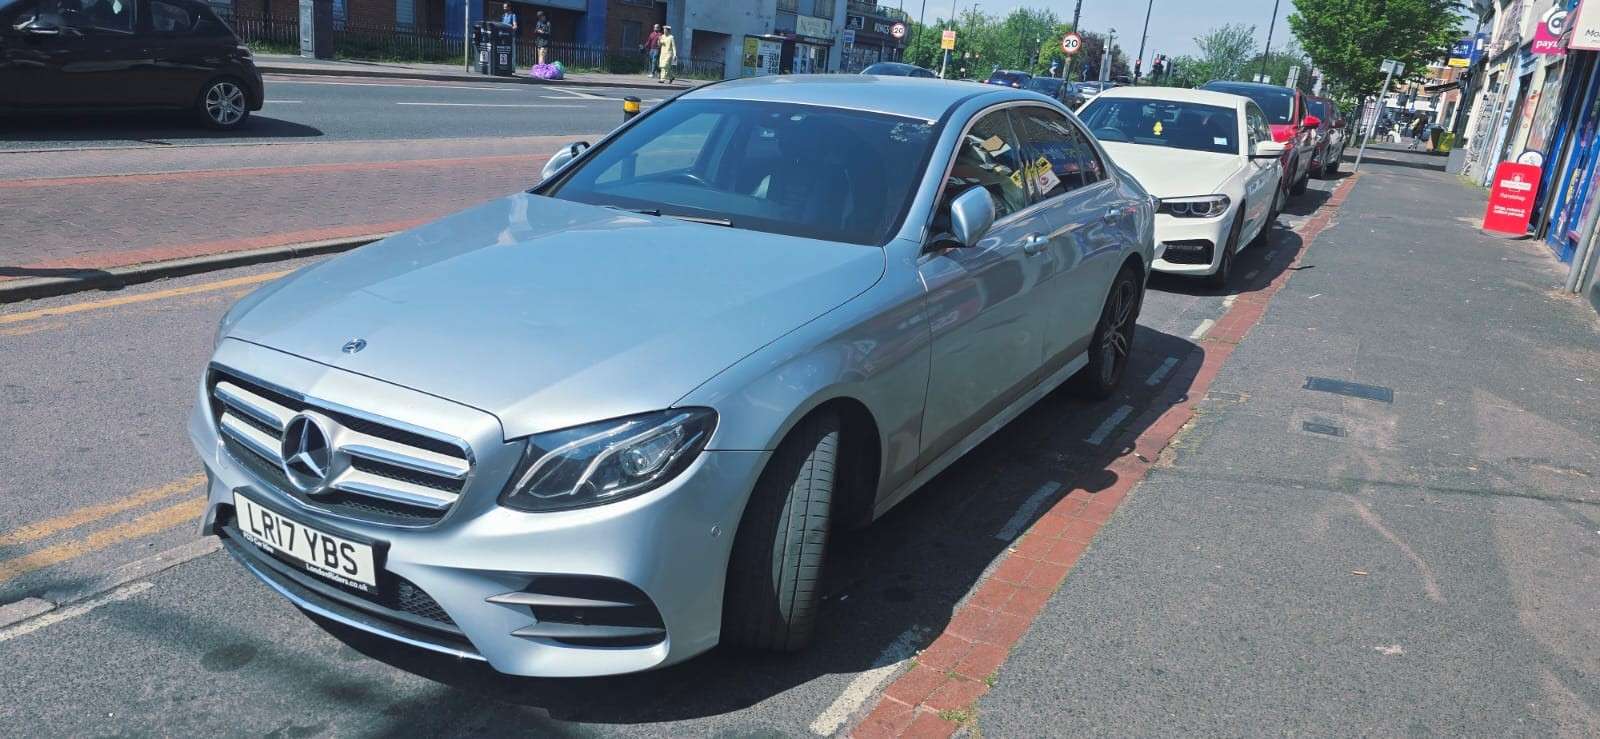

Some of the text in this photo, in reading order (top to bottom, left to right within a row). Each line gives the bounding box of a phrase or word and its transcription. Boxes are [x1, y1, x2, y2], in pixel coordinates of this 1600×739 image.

[1065, 39, 1078, 48] 20
[247, 502, 358, 576] LR17 YBS
